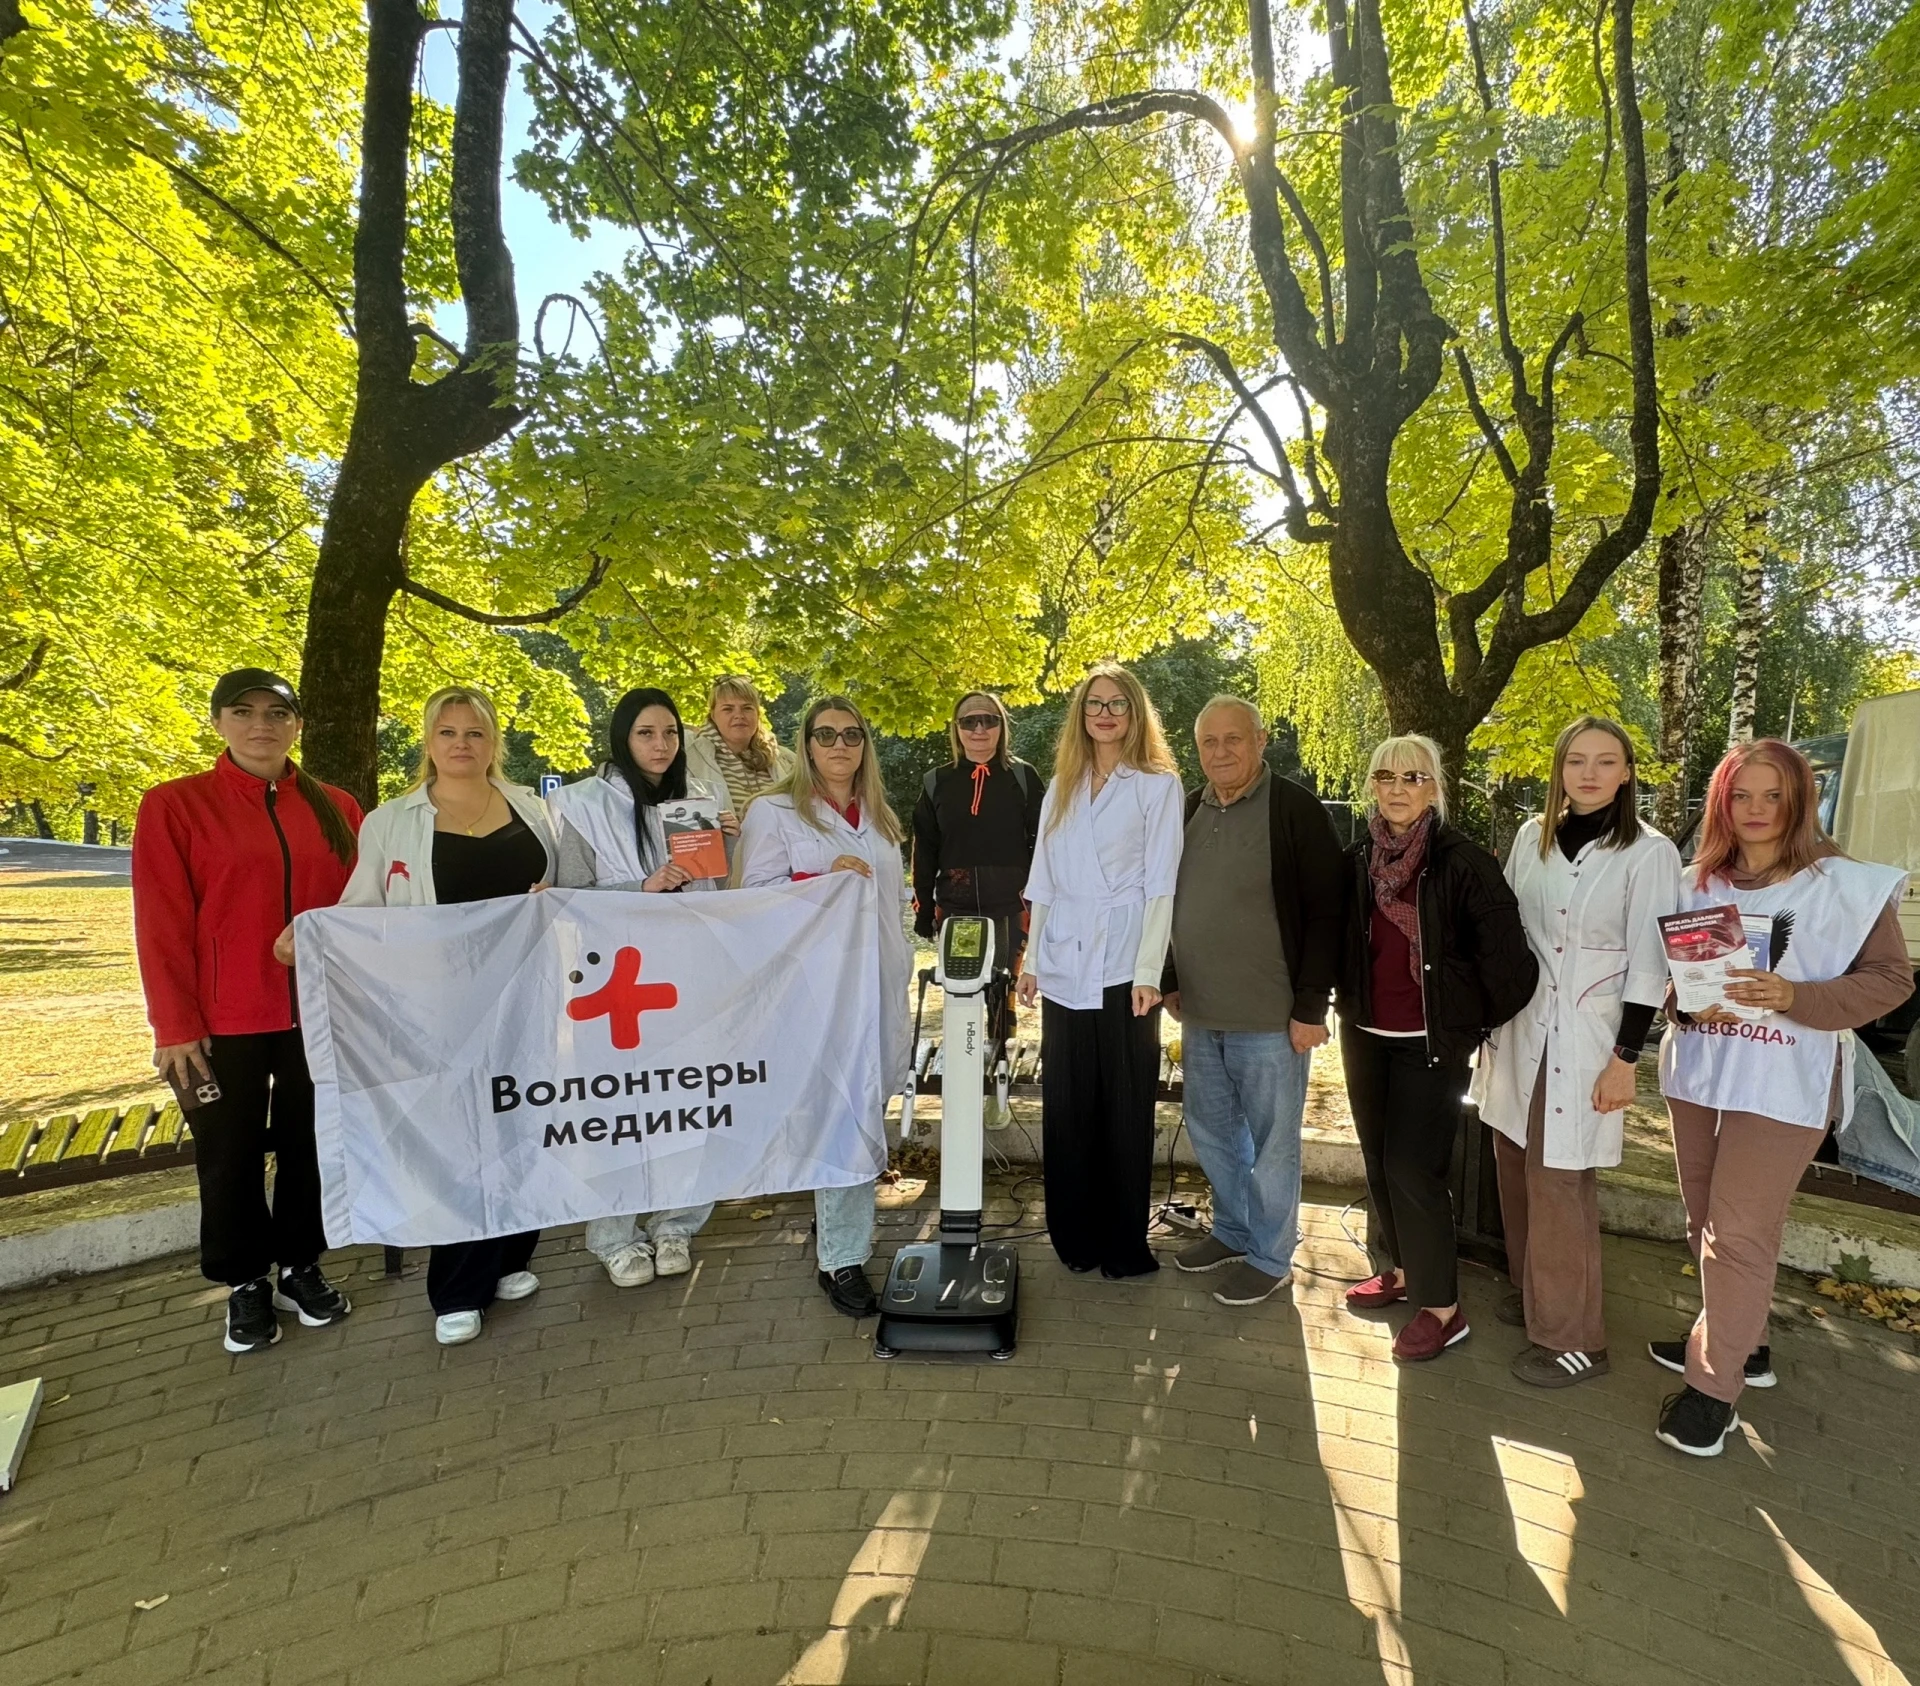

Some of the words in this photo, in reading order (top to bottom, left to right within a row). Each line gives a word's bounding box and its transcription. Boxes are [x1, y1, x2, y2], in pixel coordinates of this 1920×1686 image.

[1664, 918, 1692, 928] ДЕРЖАТЬ
[1692, 913, 1725, 923] ДАВЛЕНИЕ
[1680, 920, 1718, 930] КОНТРОЛЕМ
[964, 1021, 976, 1056] InBody
[491, 1060, 767, 1114] Волонтеры
[542, 1103, 733, 1148] медики
